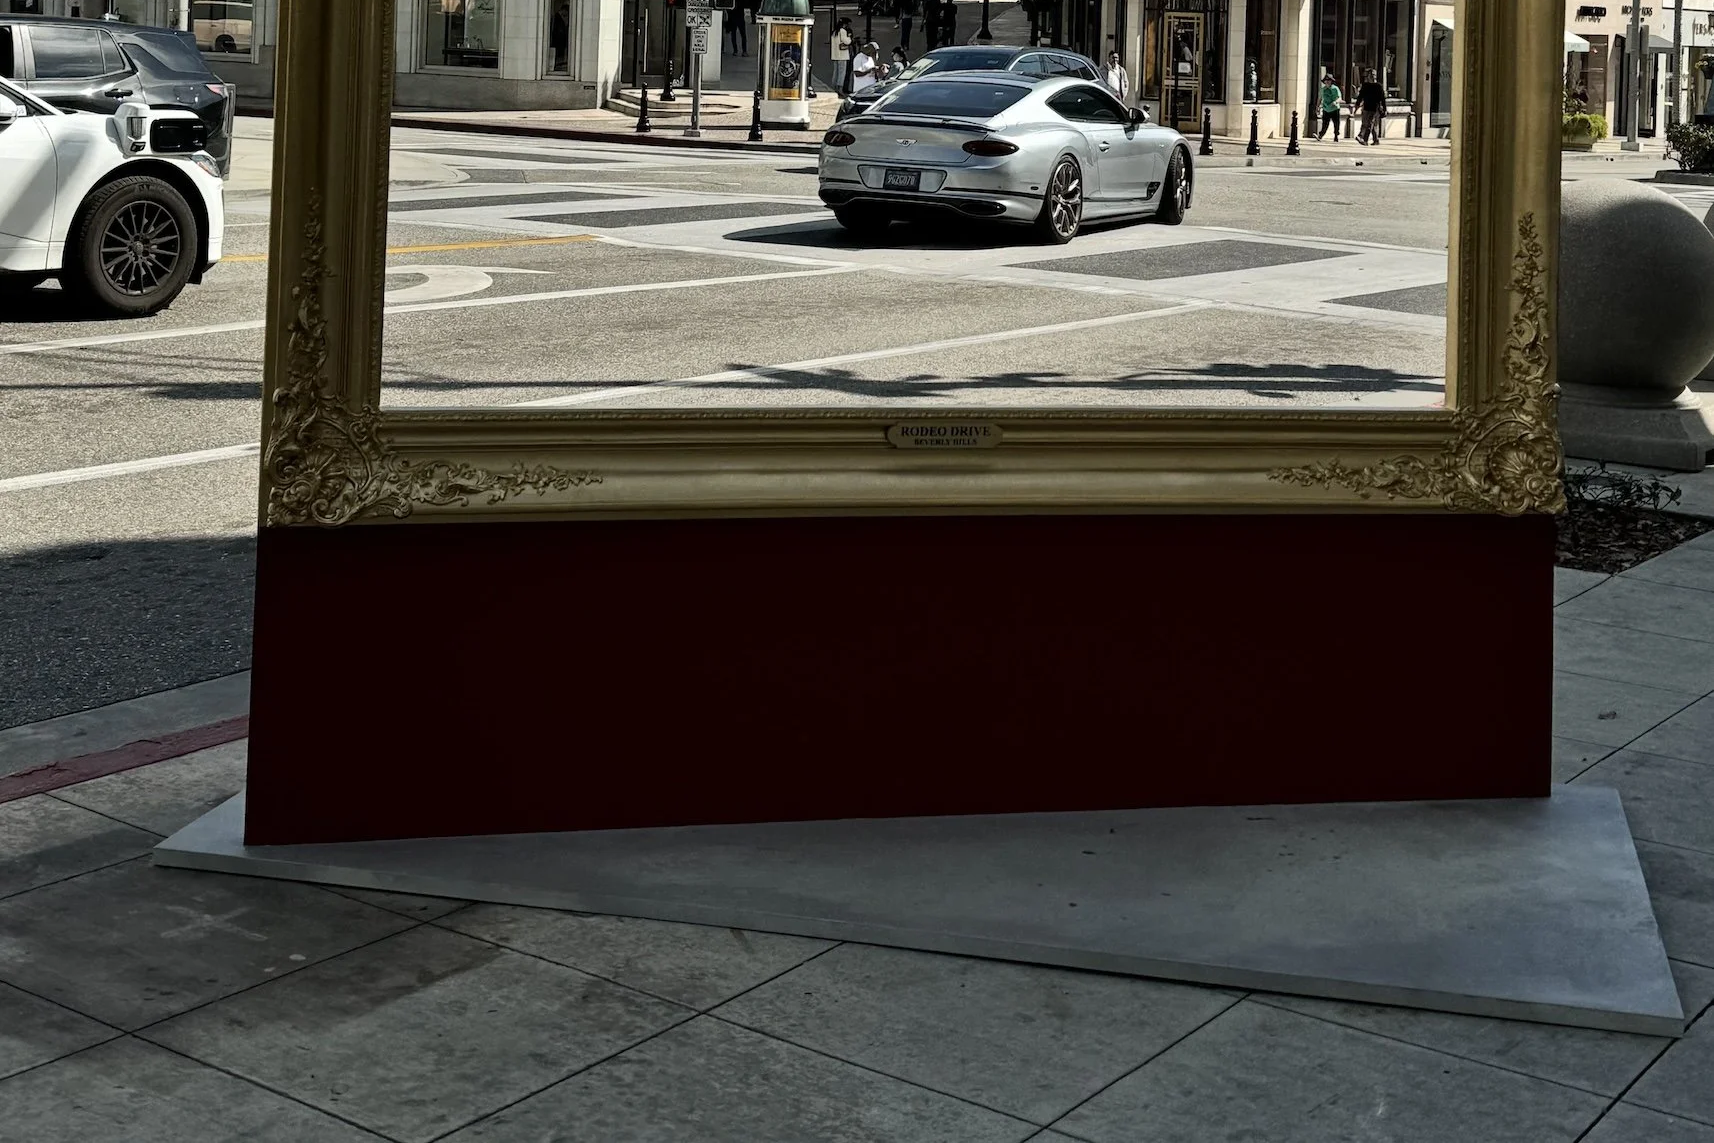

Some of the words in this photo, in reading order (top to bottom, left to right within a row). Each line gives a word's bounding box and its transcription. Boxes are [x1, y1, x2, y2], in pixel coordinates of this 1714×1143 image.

[687, 15, 697, 24] OK
[901, 426, 947, 437] RODEO
[950, 426, 991, 437] DRIVE
[914, 438, 951, 446] BEVERLY
[953, 438, 977, 446] HILLS
